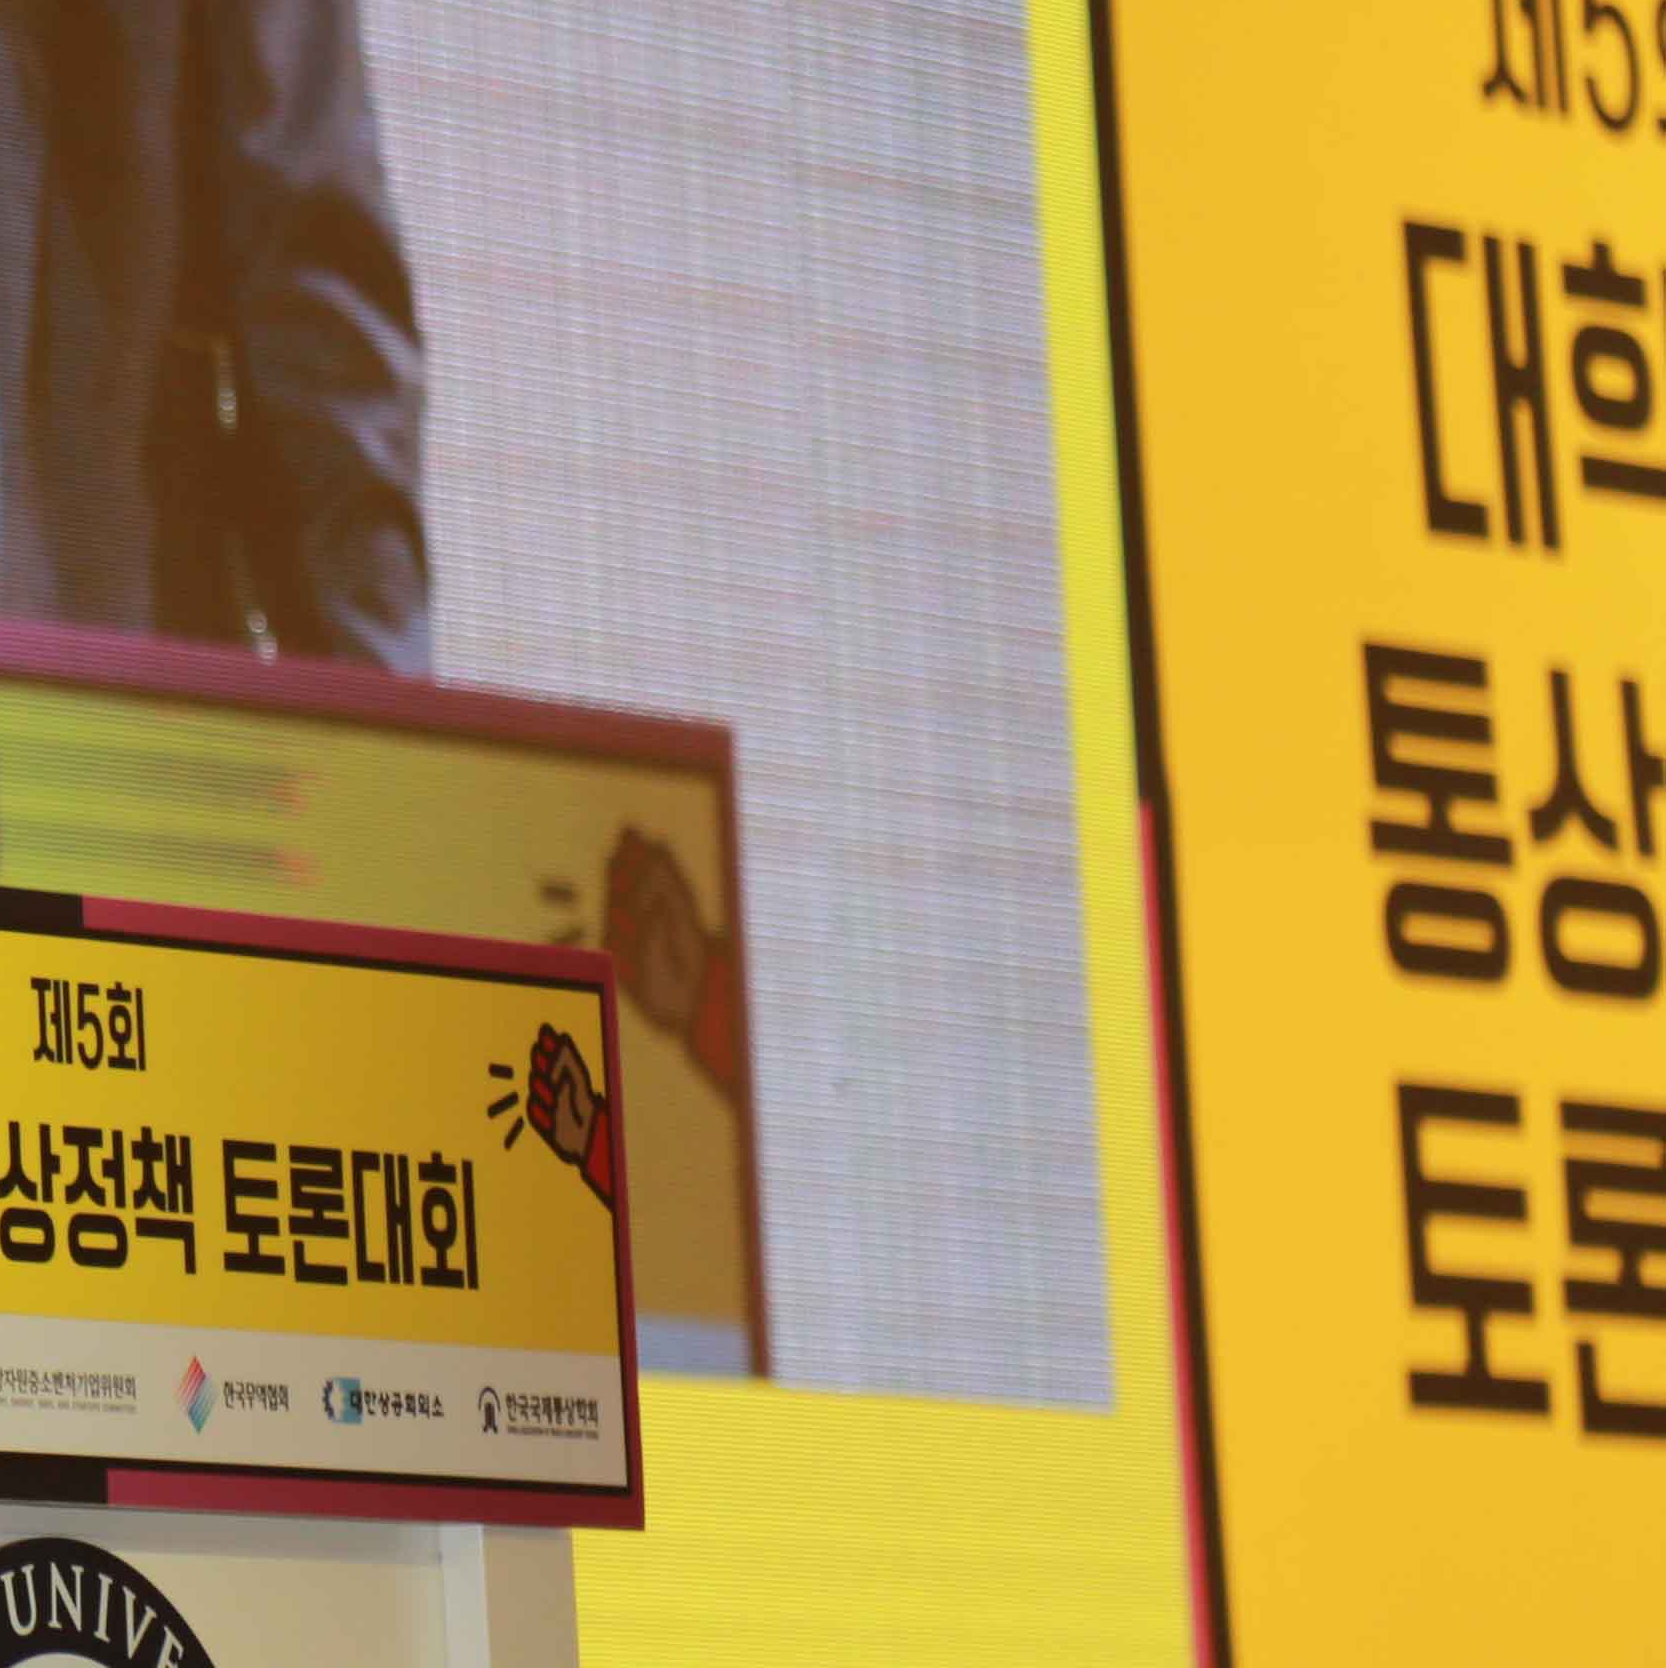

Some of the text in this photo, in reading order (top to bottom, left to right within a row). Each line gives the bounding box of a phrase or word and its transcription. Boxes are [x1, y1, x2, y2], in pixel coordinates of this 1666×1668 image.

[1362, 640, 1666, 1000] 통상
[30, 976, 146, 1071] 제5회
[222, 1139, 481, 1291] 토론대회
[223, 1380, 290, 1412] 한국무역협회
[350, 1389, 445, 1418] 대한상공회의소
